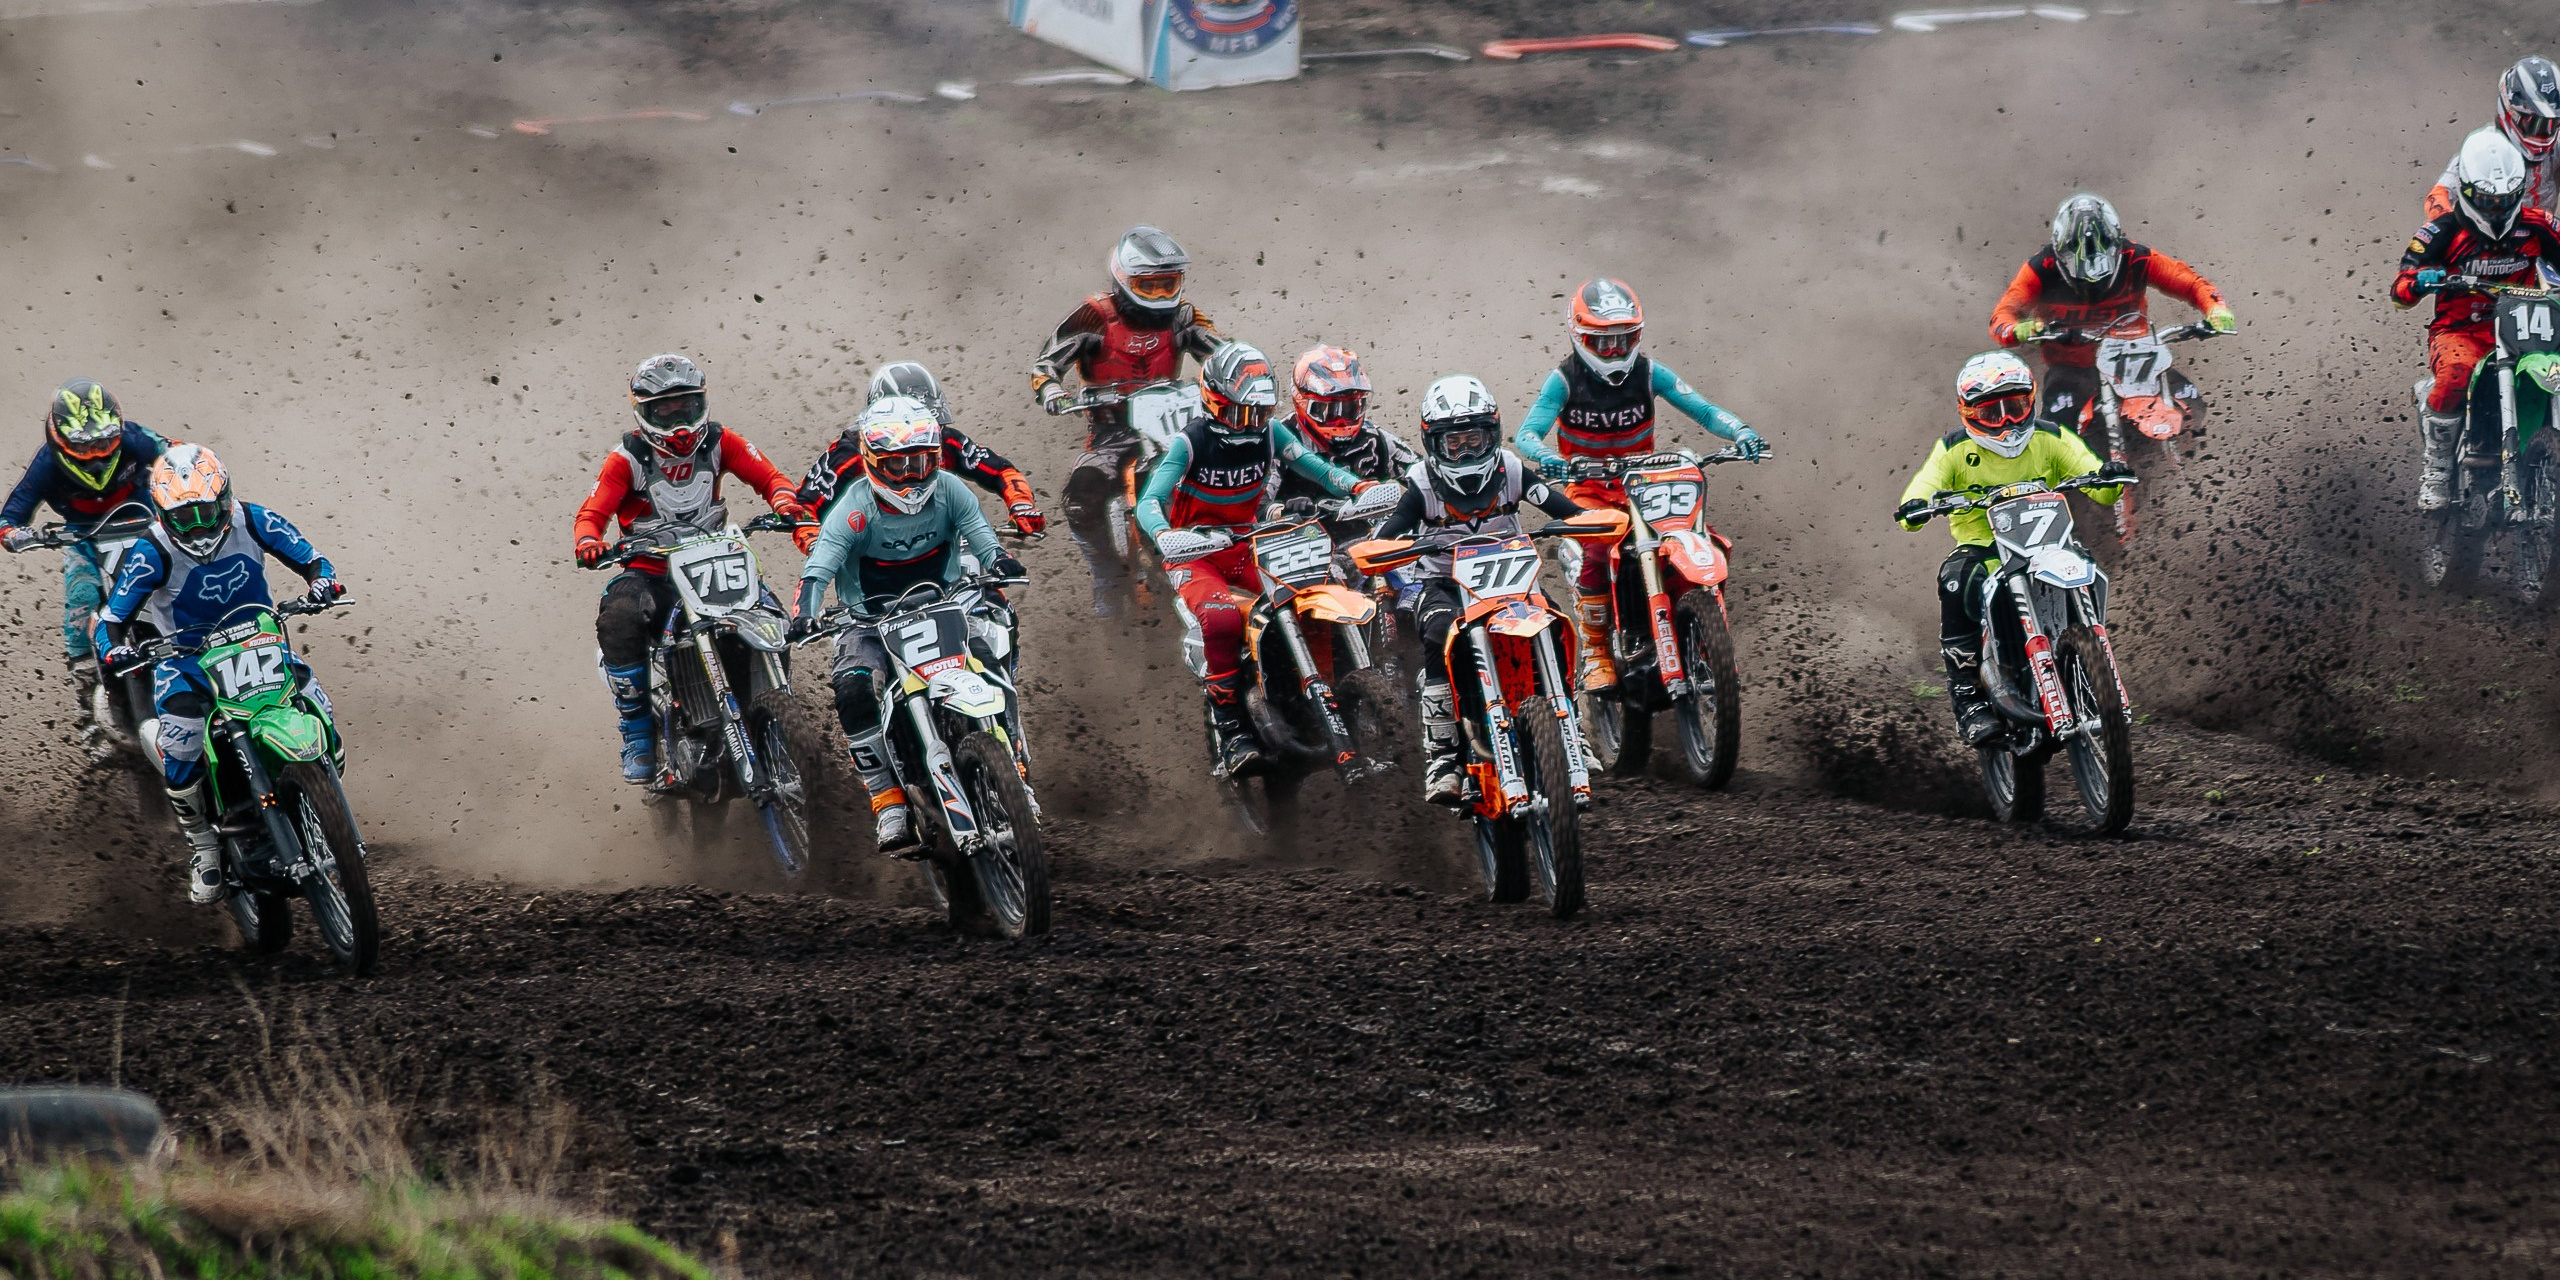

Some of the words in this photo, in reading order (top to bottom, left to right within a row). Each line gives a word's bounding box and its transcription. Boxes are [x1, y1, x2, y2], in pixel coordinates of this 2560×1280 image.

[2508, 303, 2554, 342] 14
[2107, 351, 2159, 386] 17
[1158, 404, 1194, 436] 117
[1569, 404, 1645, 428] SEVEN
[1198, 461, 1265, 487] SEVEN
[1641, 484, 1698, 522] 33
[2019, 508, 2059, 548] 7
[1268, 537, 1332, 578] 222
[1469, 554, 1539, 592] 317
[690, 558, 748, 598] 715
[889, 617, 914, 632] thor
[901, 618, 941, 668] 2
[215, 645, 286, 700] 142
[923, 657, 961, 677] MOTUL
[161, 721, 198, 746] FOX
[724, 721, 744, 762] YAMAHA
